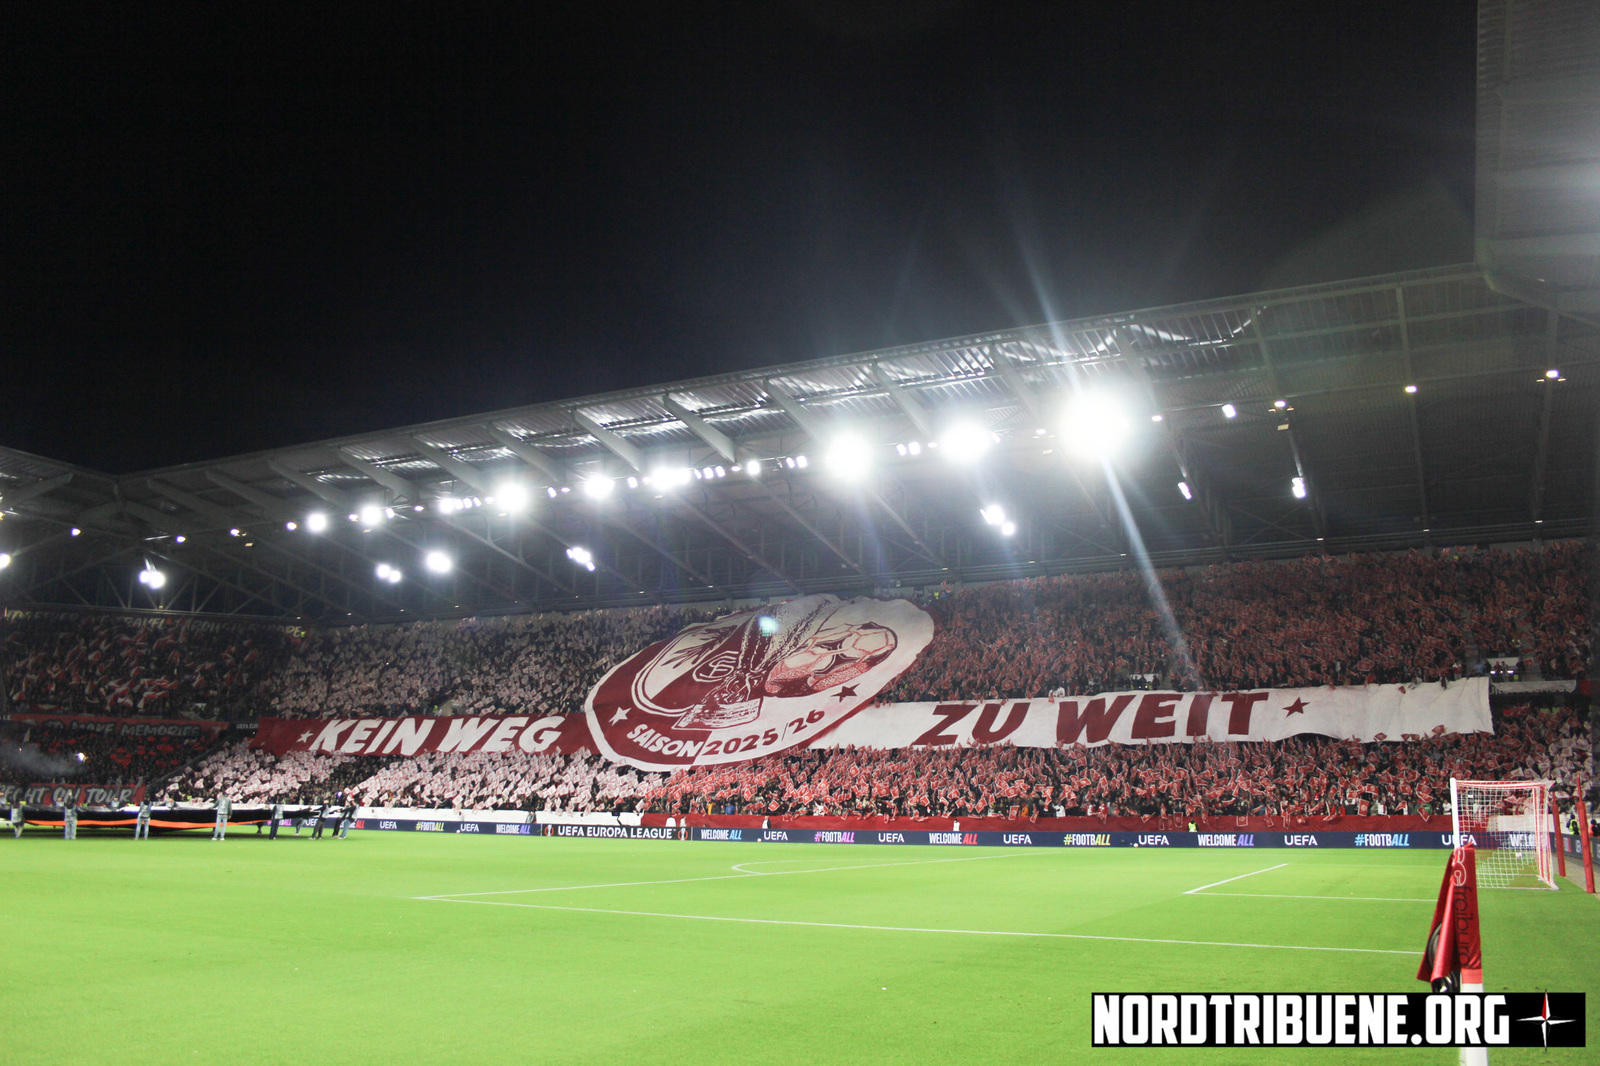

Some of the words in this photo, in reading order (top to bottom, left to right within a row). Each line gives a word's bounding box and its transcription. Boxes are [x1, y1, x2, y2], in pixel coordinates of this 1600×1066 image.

[912, 702, 1031, 746] ZU
[1056, 692, 1269, 744] WEIT
[120, 723, 201, 736] MEMORIES
[308, 718, 435, 755] KEIN
[437, 716, 566, 753] WEG
[627, 724, 705, 757] SAISON
[702, 709, 825, 756] 2025/26
[379, 820, 398, 830] UEFA
[415, 821, 445, 831] #FOOTBALL
[460, 823, 479, 833] UEFA
[496, 824, 520, 834] WELCOME
[520, 824, 531, 834] ALL
[558, 826, 584, 837] UEFA
[586, 826, 628, 838] EUROPA
[630, 827, 673, 839] LEAGUE
[701, 829, 729, 840] WELCOME
[729, 829, 742, 840] ALL
[763, 830, 789, 841] UEFA
[814, 831, 855, 843] #FOOTBALL
[878, 832, 905, 843] UEFA
[929, 832, 962, 844] WELCOME
[962, 833, 978, 845] ALL
[1003, 834, 1032, 845] UEFA
[1063, 833, 1111, 846] #FOOTBALL
[1138, 834, 1170, 846] UEFA
[1198, 834, 1237, 846] WELCOME
[1237, 834, 1255, 846] ALL
[1284, 834, 1318, 846] UEFA
[1354, 833, 1410, 847] #FOOTBALL
[1441, 834, 1477, 846] UFA
